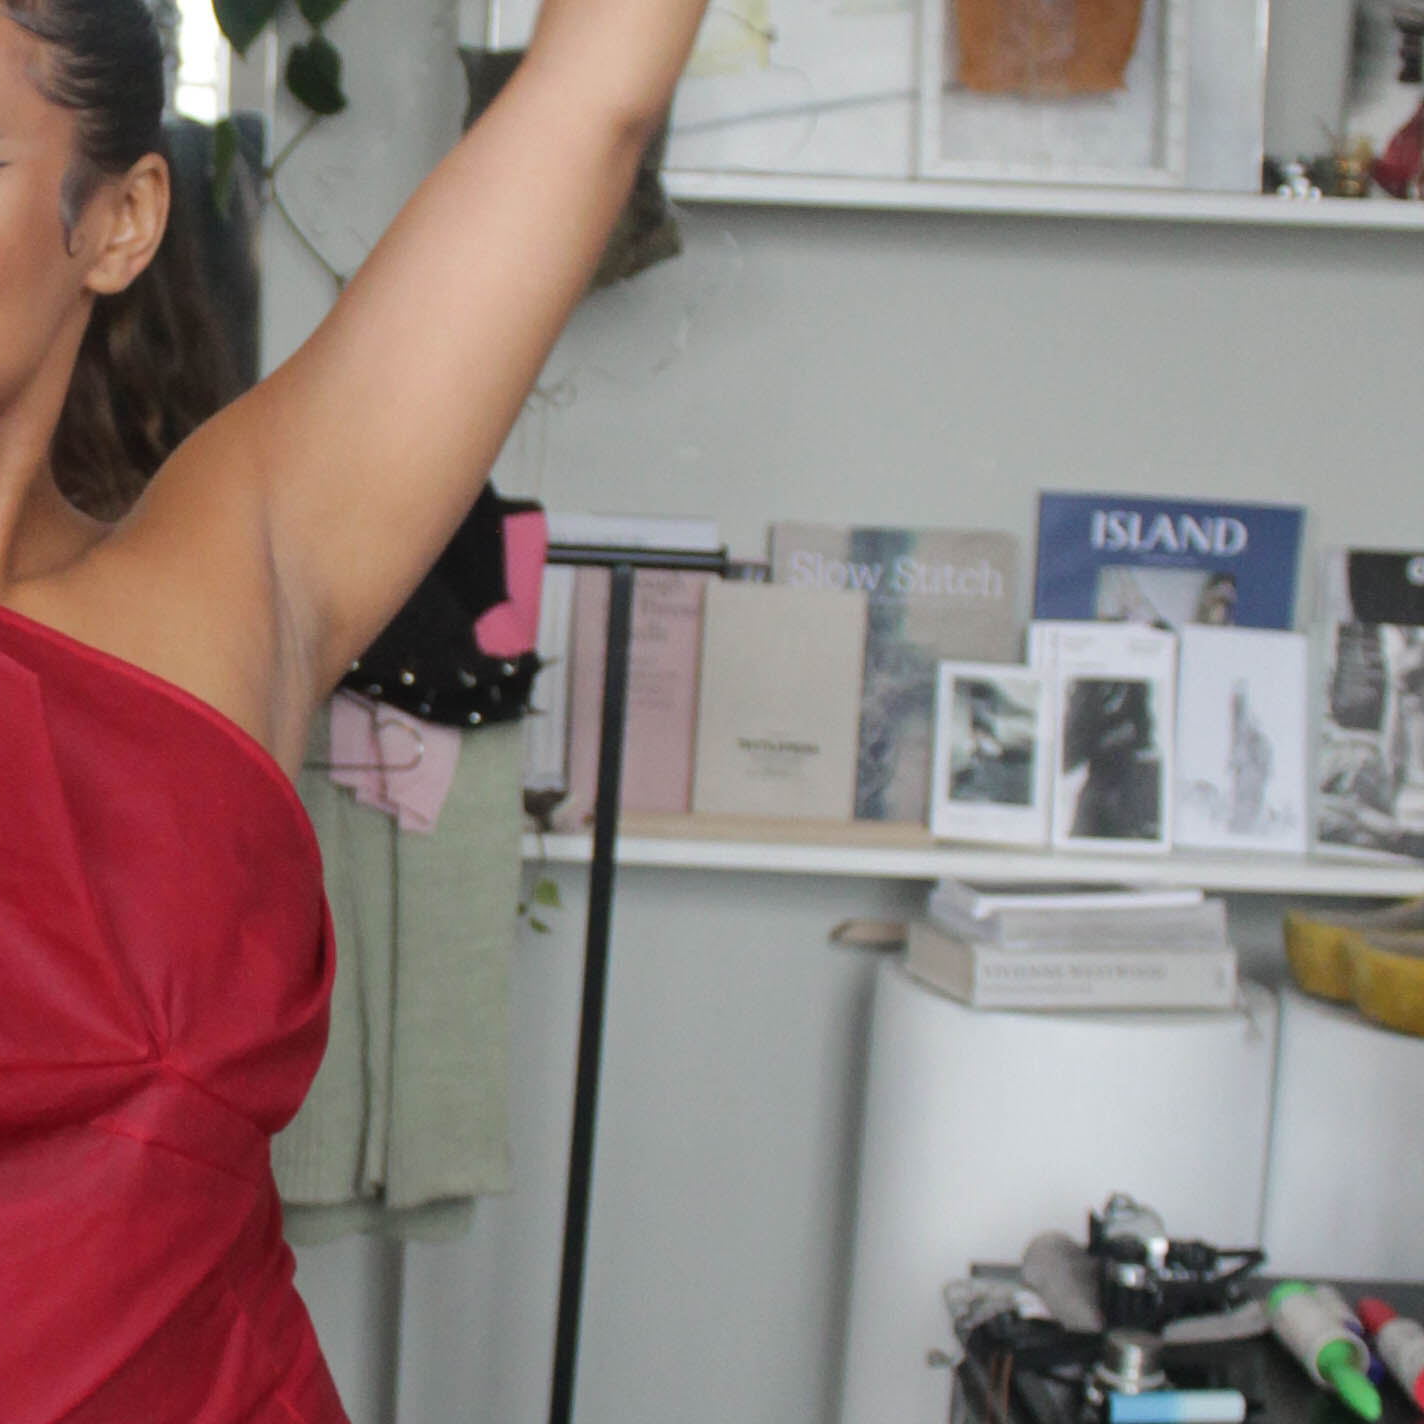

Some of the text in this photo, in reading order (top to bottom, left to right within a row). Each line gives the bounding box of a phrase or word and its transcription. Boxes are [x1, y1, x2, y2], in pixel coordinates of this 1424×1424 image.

[1090, 509, 1248, 557] ISLAND
[790, 551, 1002, 599] Slow Stitch
